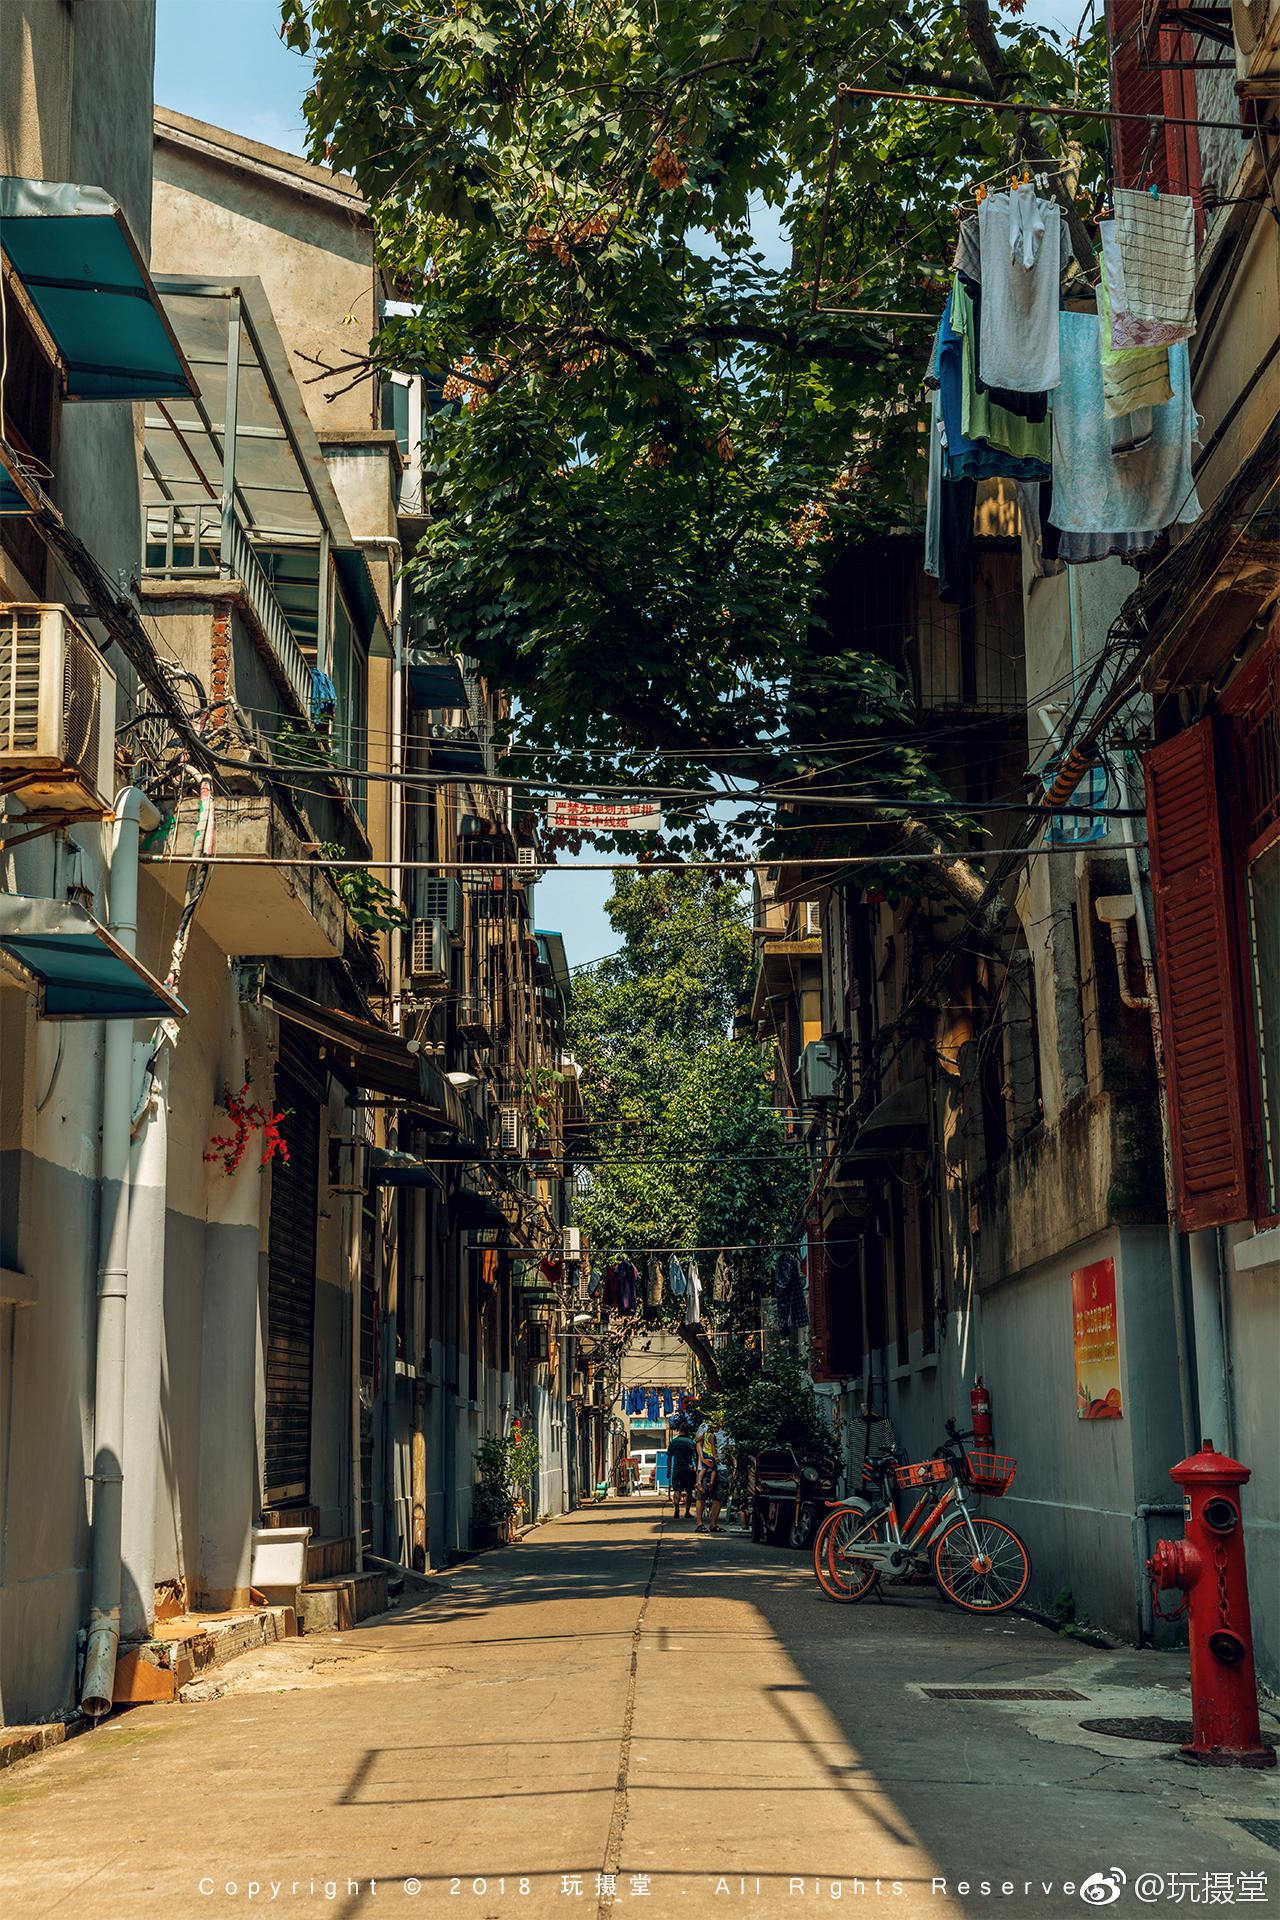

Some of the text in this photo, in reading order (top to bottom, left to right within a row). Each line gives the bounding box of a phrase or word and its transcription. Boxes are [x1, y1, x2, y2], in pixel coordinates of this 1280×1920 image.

[554, 801, 654, 816] 严禁无规划无审批
